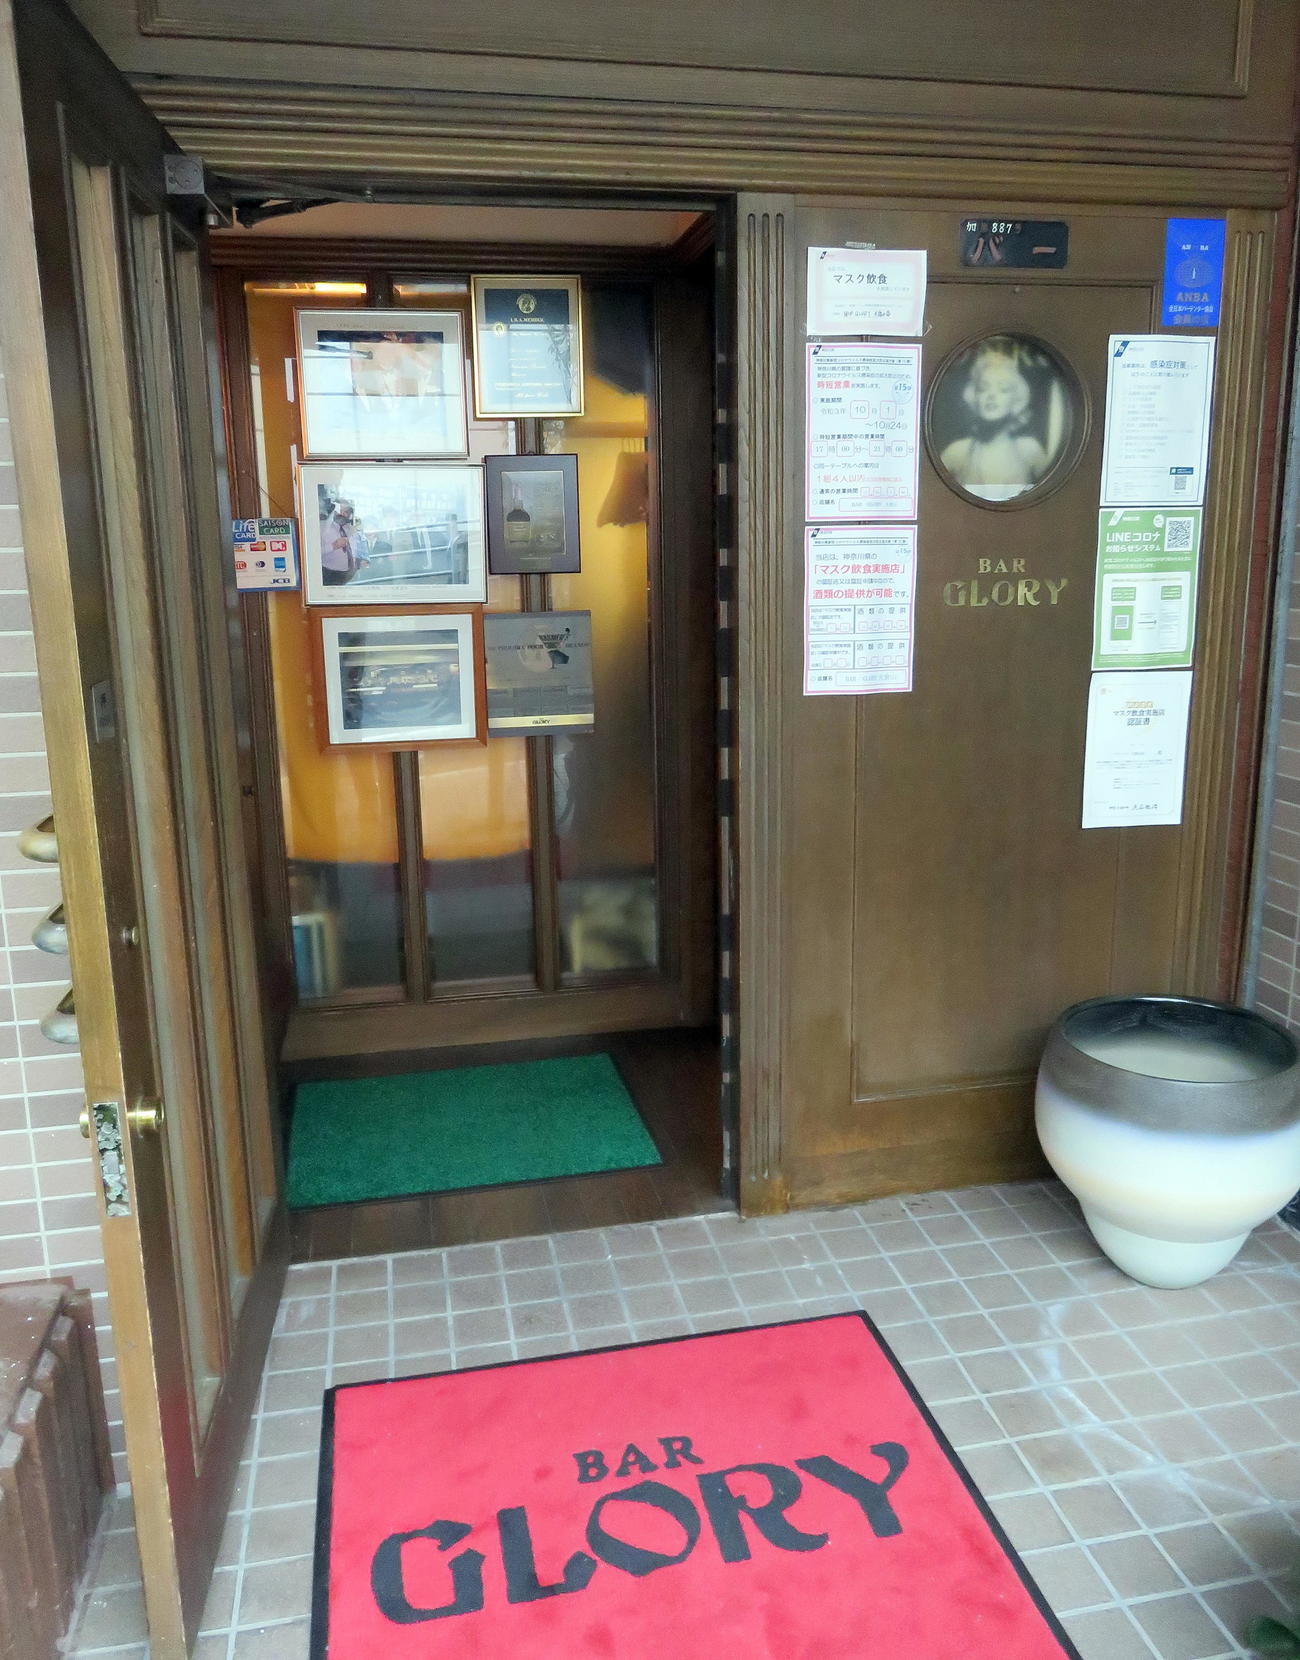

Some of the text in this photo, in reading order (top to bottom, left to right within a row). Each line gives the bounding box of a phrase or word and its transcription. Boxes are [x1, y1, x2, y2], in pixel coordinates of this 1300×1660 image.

[991, 222, 1012, 233] 887
[969, 235, 1057, 264] バー
[832, 273, 888, 285] マスク飲食
[854, 405, 866, 414] 10
[1106, 531, 1161, 543] LINEコロナ
[978, 558, 1026, 573] BAR
[943, 579, 1069, 606] GLORY
[573, 1436, 704, 1484] BAR
[371, 1442, 909, 1625] GLORY
